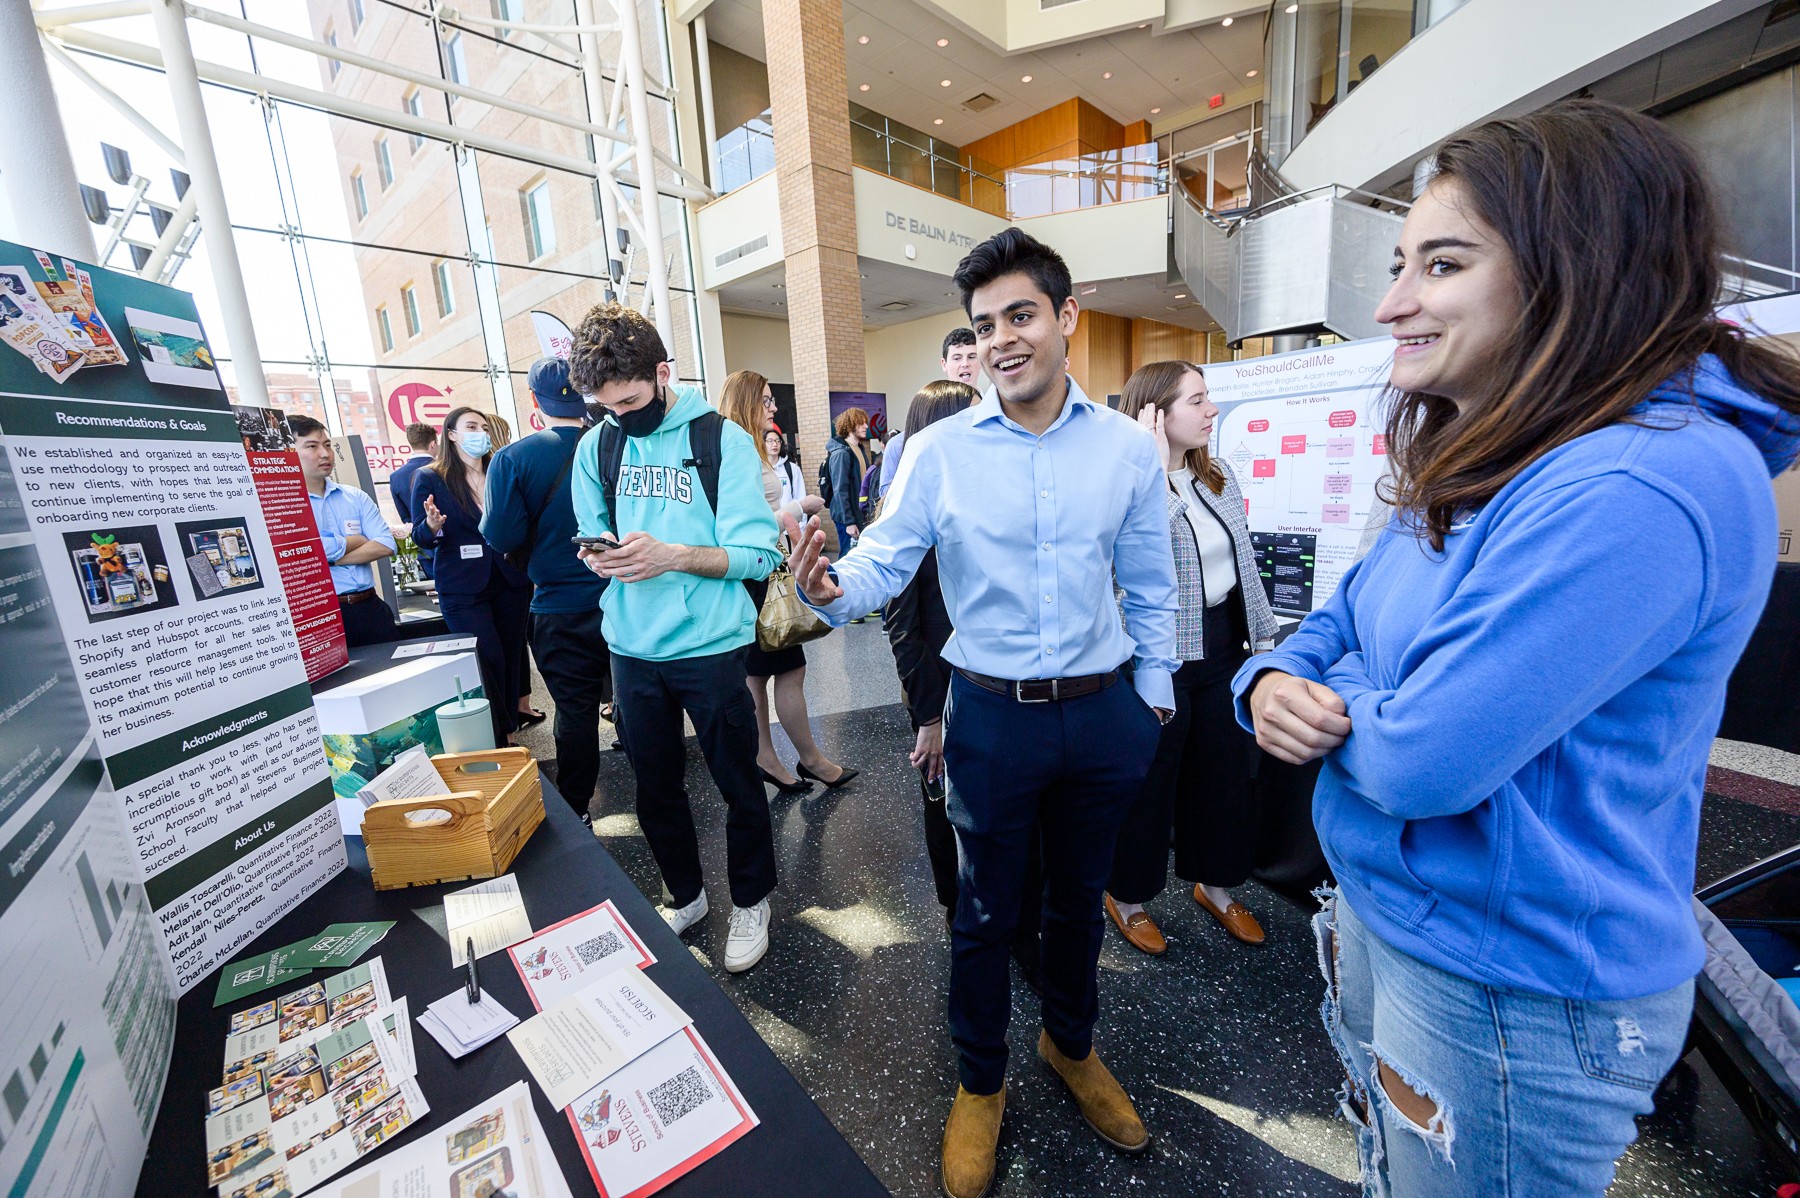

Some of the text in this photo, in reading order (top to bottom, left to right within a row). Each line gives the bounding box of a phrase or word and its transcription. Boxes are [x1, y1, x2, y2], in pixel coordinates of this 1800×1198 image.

[885, 211, 906, 231] DE
[909, 218, 946, 242] BAUN
[1235, 354, 1335, 379] YouShouldCallMe
[1252, 379, 1274, 388] Hunter
[1278, 384, 1308, 392] Brendan
[1310, 379, 1338, 389] Sullivan
[1309, 396, 1331, 404] Works
[55, 411, 207, 431] Recommendations & Goals
[13, 447, 243, 461] We established and organized an easy-to-
[252, 457, 287, 465] STRATEGIC
[369, 458, 405, 470] EXP
[20, 463, 247, 476] use methodology to prospect and outreach
[250, 466, 300, 474] COMMENDATIONS
[25, 481, 40, 491] to
[50, 480, 75, 491] new
[84, 479, 124, 491] clients,
[130, 477, 154, 488] with
[159, 477, 189, 488] hopes
[193, 476, 211, 486] that
[217, 475, 233, 485] Jess
[236, 475, 250, 484] will
[616, 464, 692, 504] TEVENS
[31, 496, 87, 508] continue
[91, 493, 165, 506] implementing
[168, 492, 179, 500] to
[182, 490, 207, 500] serve
[209, 489, 223, 498] the
[226, 488, 244, 499] goal
[246, 487, 254, 496] of
[36, 502, 218, 525] onboarding new corporate clients.
[1293, 526, 1323, 534] Interface
[279, 545, 312, 558] NEXT STEPS
[73, 636, 98, 651] The
[101, 631, 123, 644] last
[126, 625, 150, 642] step
[153, 620, 165, 632] of
[167, 617, 184, 629] our
[187, 609, 220, 626] project
[221, 604, 238, 617] was
[240, 602, 249, 612] to
[250, 598, 266, 610] link
[266, 594, 284, 606] Jess'
[79, 646, 125, 666] Shopify
[131, 639, 151, 653] and
[157, 628, 200, 646] Hubspot
[204, 618, 244, 634] accounts,
[248, 609, 278, 624] creating
[280, 606, 287, 614] a
[309, 645, 325, 655] ABOUT
[102, 709, 175, 739] her business.
[182, 709, 269, 752] Acknowledgments
[124, 714, 316, 806] A special thank you to Jess, who has been
[234, 820, 276, 851] About Us
[144, 846, 189, 874] succeed.
[158, 809, 333, 925] Wallis Toscarelli, Quantitative Finance 2022
[163, 908, 204, 938] Melanie
[244, 850, 292, 884] Quantitative
[291, 832, 319, 853] Finance
[319, 817, 338, 834] 2022
[168, 844, 316, 952] Adit Jain, Quantitative Finance 2022
[171, 837, 343, 964] Kendall Niles-Peretz, Quantitative Finance
[179, 858, 346, 988] Charles McLellan, Quantitative Finance 2022
[176, 950, 204, 976] 2022
[547, 950, 572, 982] STEVENS
[633, 1088, 650, 1114] Business
[612, 1097, 648, 1153] STEVENS
[648, 1118, 664, 1140] School
